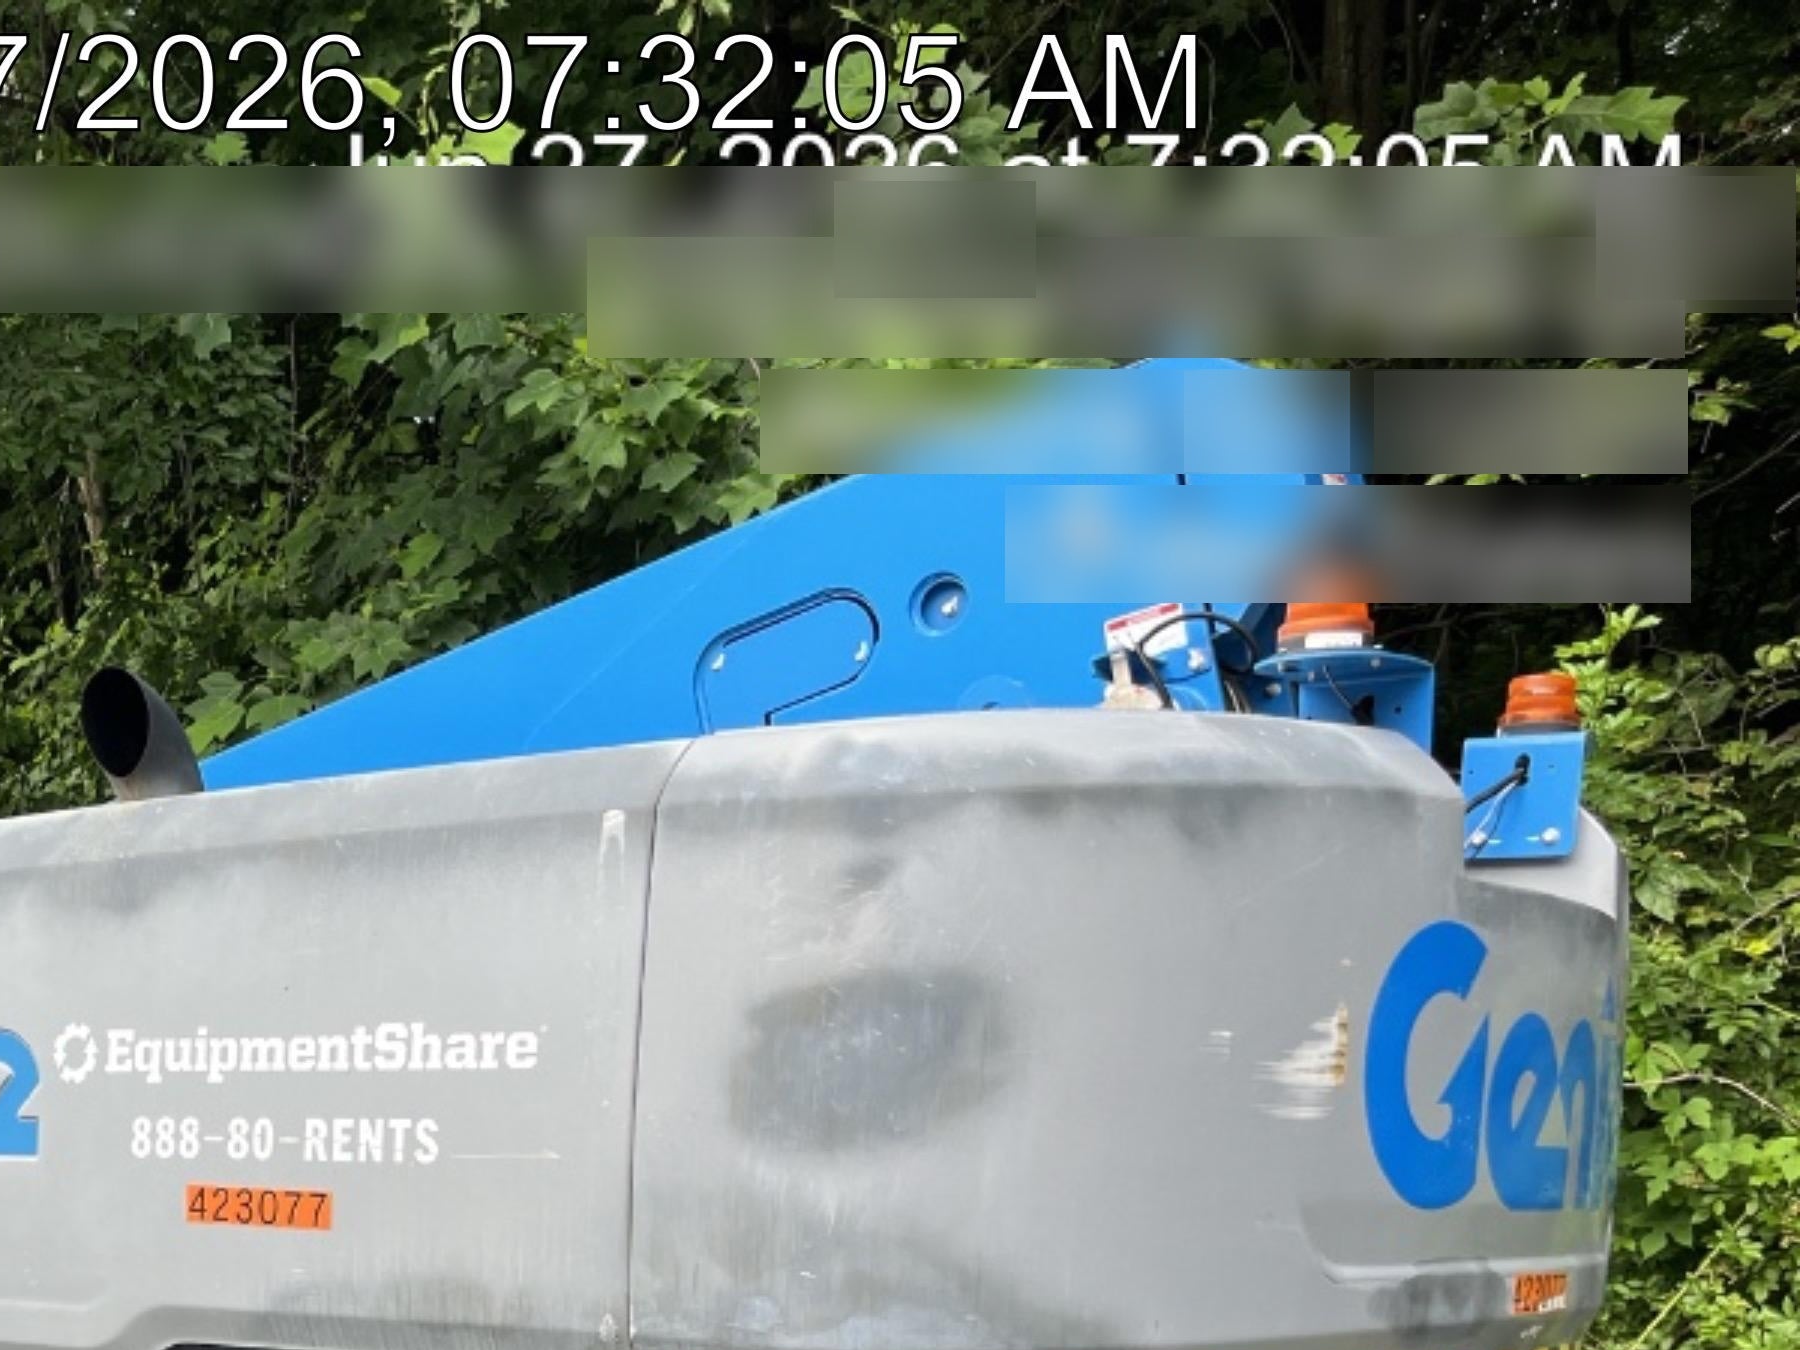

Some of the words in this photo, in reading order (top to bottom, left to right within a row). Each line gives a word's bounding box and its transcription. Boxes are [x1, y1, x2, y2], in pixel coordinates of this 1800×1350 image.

[104, 1021, 540, 1084] EquipmentShare
[130, 1116, 440, 1164] 888-80-RENTS
[188, 1187, 329, 1228] 423077
